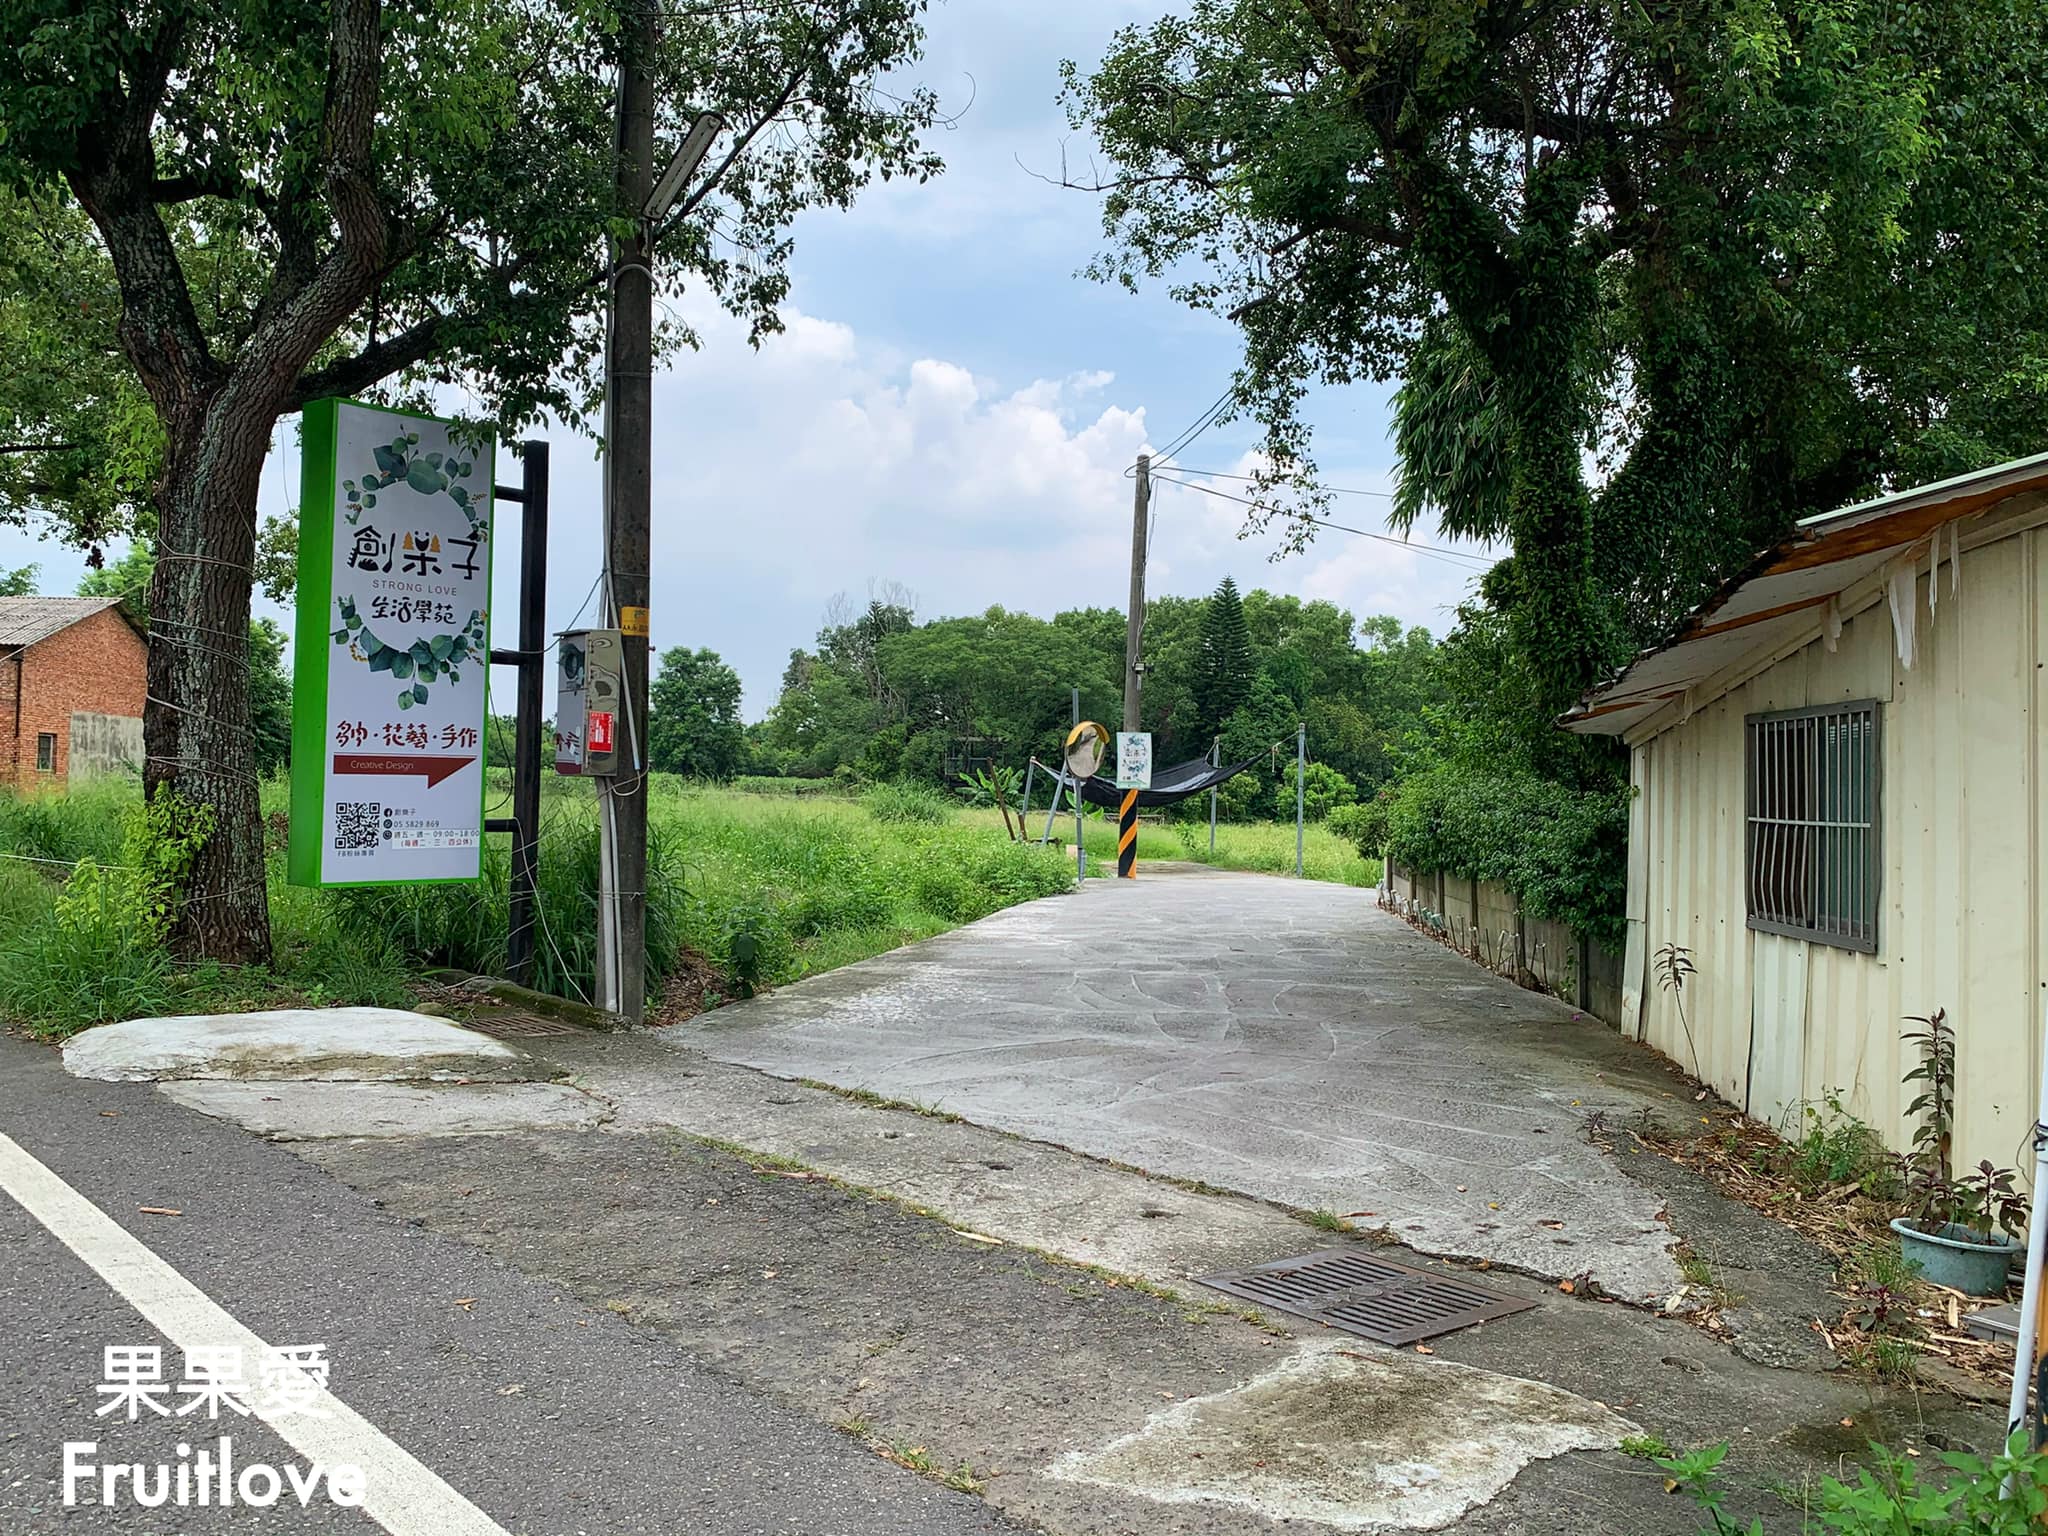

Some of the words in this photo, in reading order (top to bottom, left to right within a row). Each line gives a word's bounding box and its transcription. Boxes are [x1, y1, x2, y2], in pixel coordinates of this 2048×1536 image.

[372, 579, 423, 592] STRONG
[427, 586, 458, 596] LOVE
[371, 596, 457, 624] 生活學苑
[350, 760, 384, 769] Creative
[385, 761, 414, 770] Design
